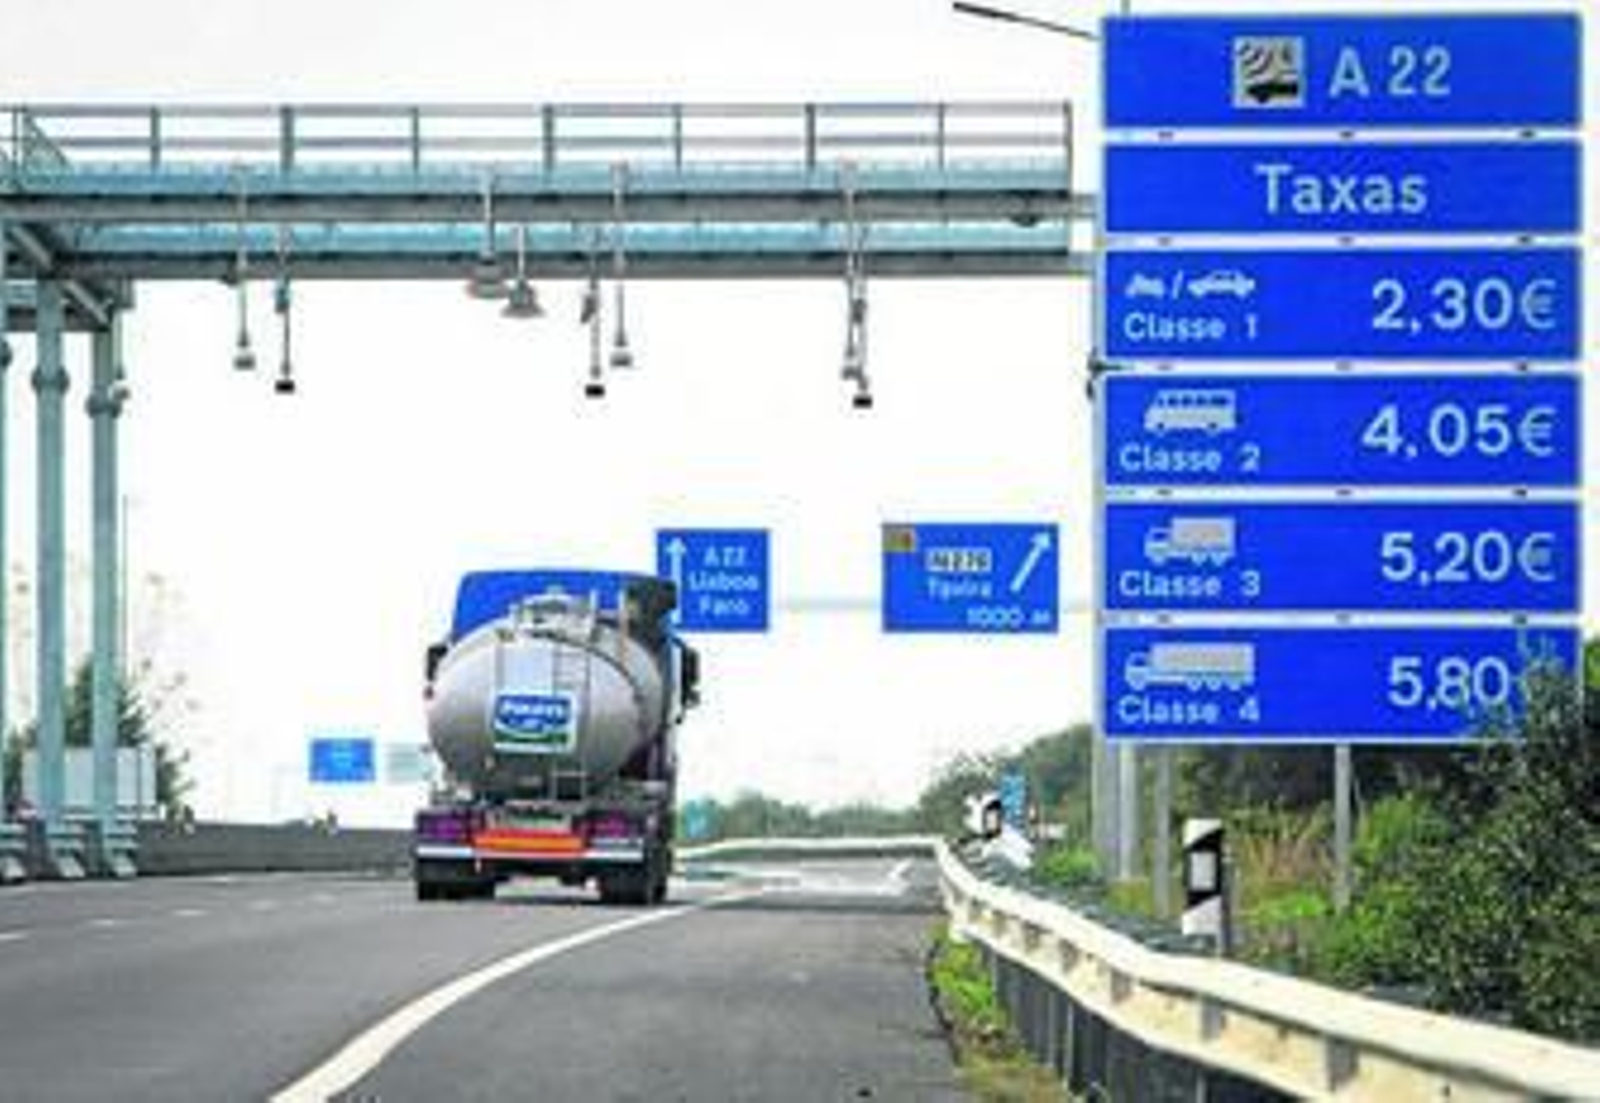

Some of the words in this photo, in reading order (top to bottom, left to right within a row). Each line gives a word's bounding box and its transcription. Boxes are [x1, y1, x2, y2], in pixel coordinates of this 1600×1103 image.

[1329, 47, 1370, 98] A
[1388, 46, 1451, 96] 22
[1255, 163, 1427, 214] Taxas
[1371, 278, 1556, 334] 2,30€
[1123, 312, 1226, 342] Classe
[1245, 313, 1257, 339] 1
[1361, 403, 1556, 458] 4,05€
[1119, 443, 1222, 472] Classe
[1240, 444, 1261, 472] 2
[1380, 530, 1556, 586] 5,20€
[690, 571, 758, 592] Lisboa
[1118, 570, 1221, 598] Classe
[1240, 570, 1261, 598] 3
[699, 595, 750, 616] Faro
[1388, 655, 1528, 710] 5,80
[1116, 696, 1220, 725] Classe
[1238, 696, 1260, 722] 4
